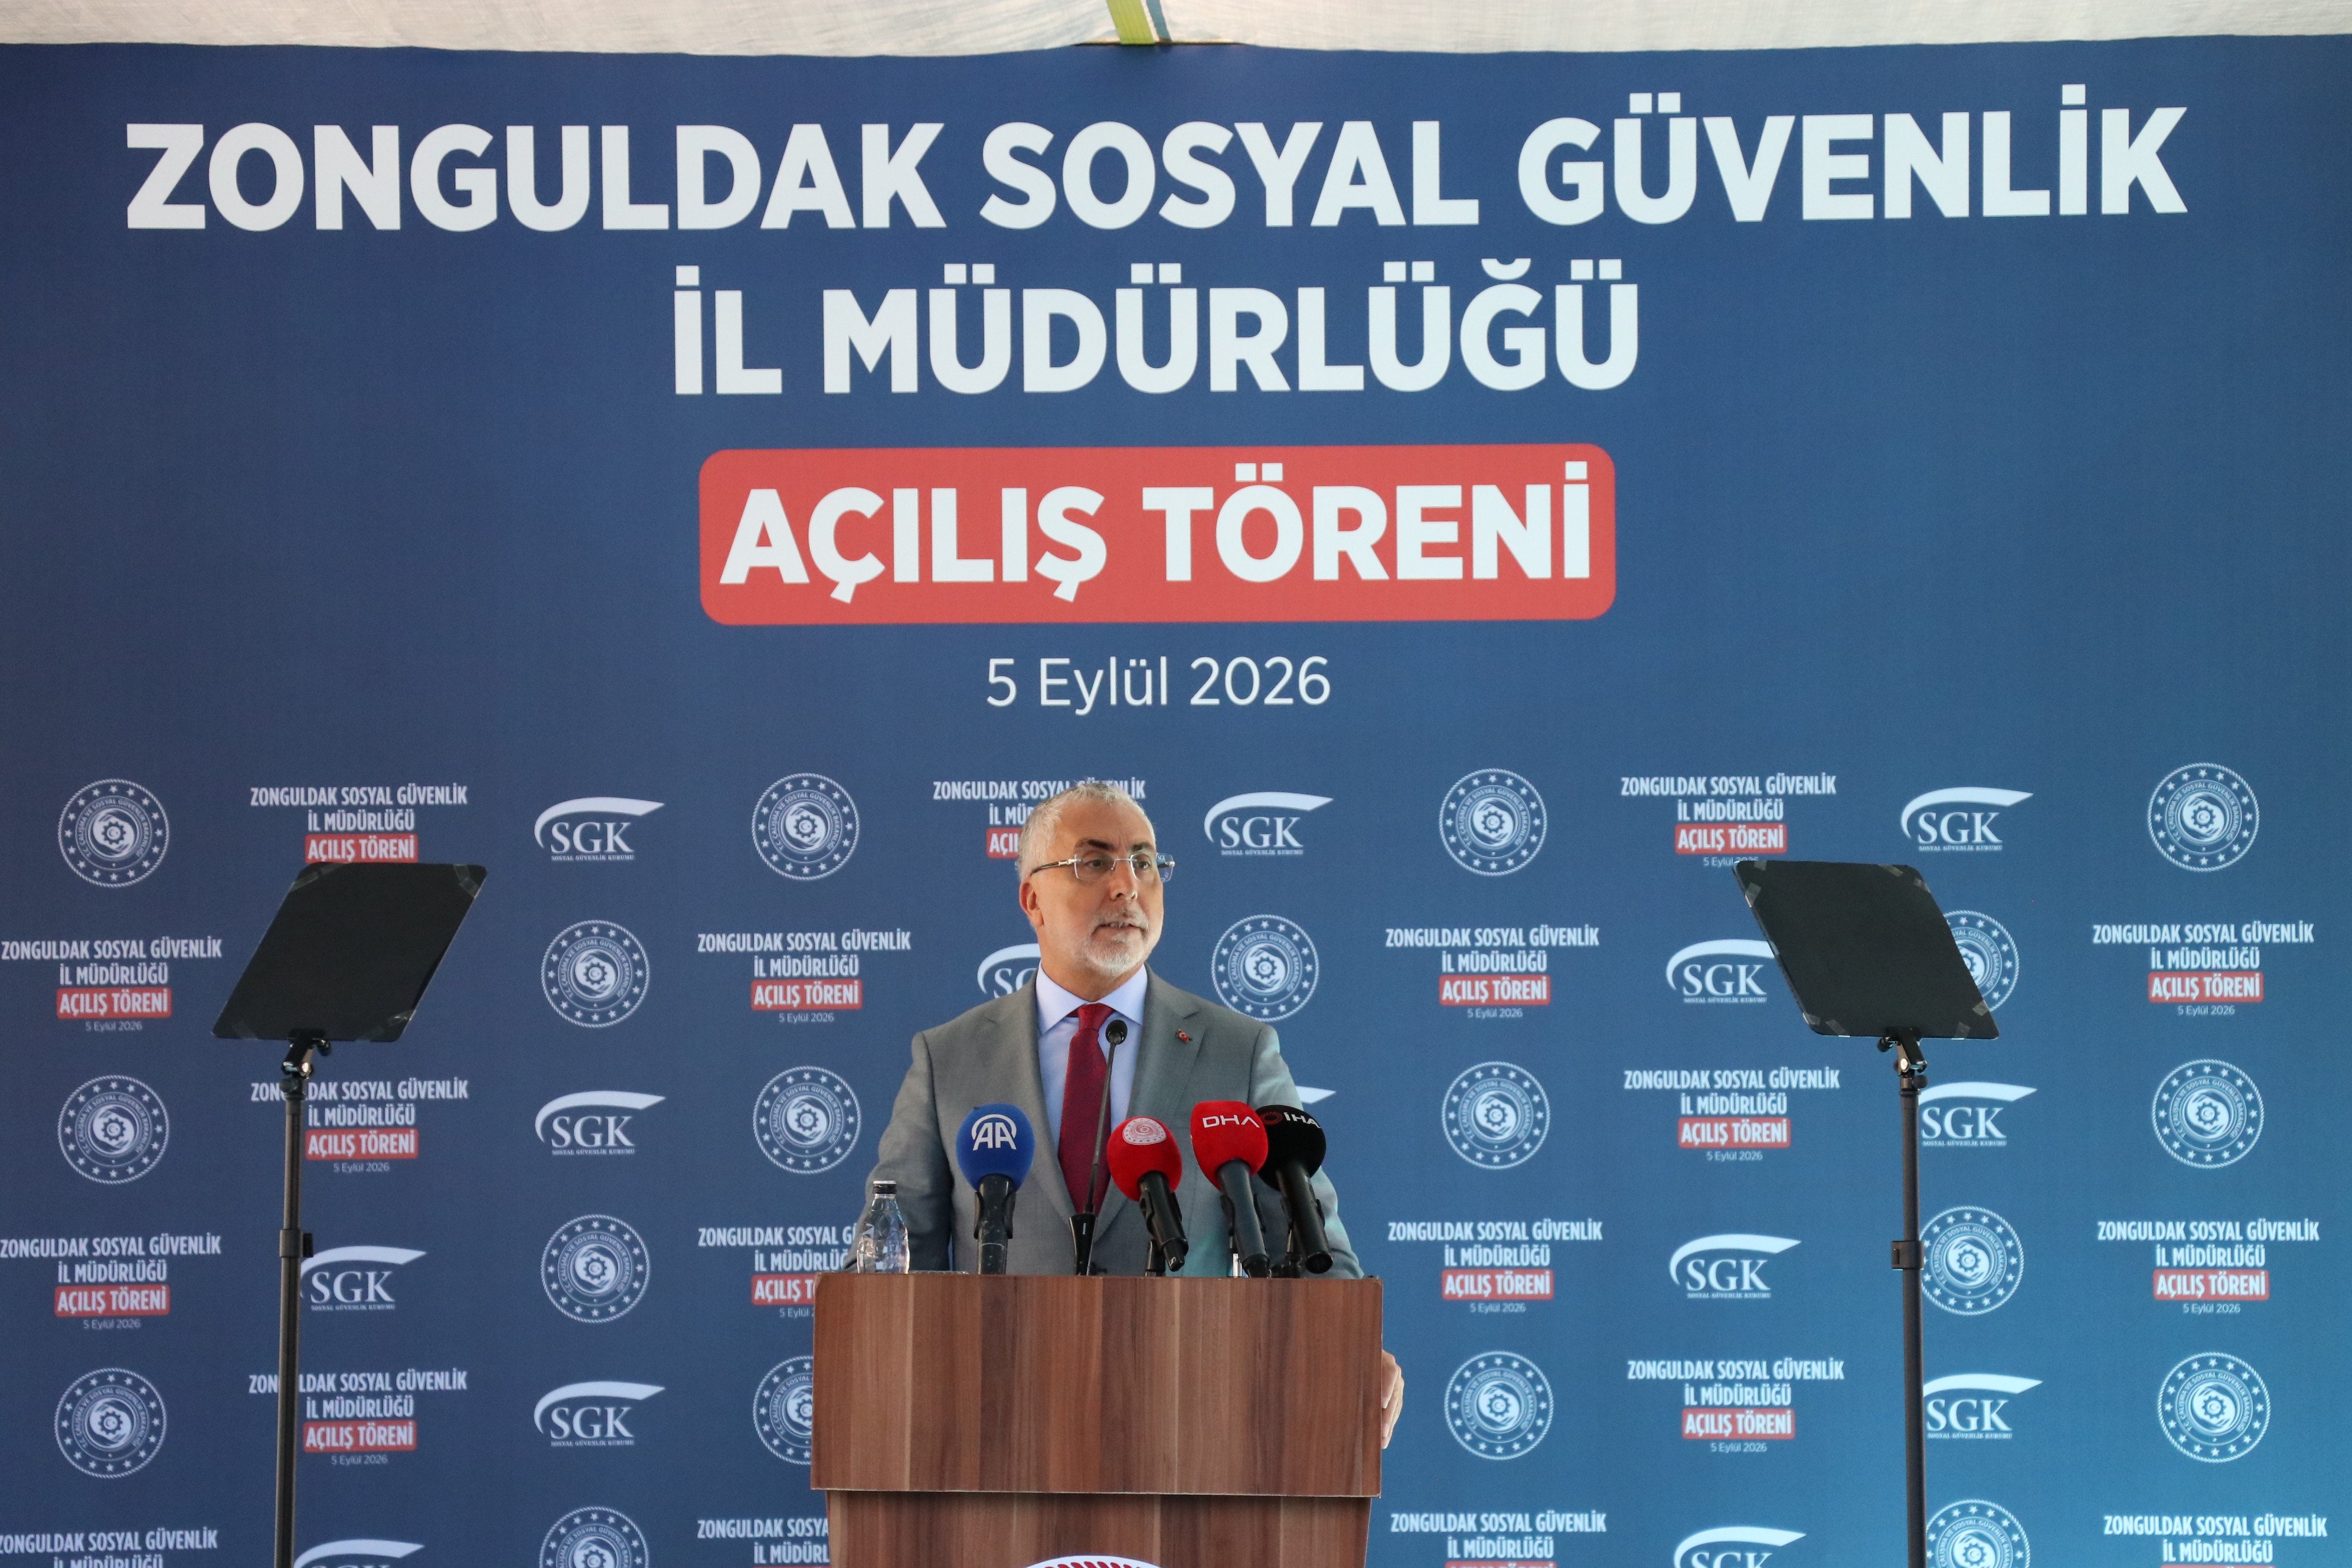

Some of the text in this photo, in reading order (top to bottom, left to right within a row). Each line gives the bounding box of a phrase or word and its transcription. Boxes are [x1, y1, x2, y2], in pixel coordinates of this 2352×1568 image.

[127, 84, 2187, 231] ZONGULDAK SOSYAL GÜVENLİK
[674, 259, 1638, 394] İL MÜDÜRLÜĞÜ
[720, 461, 1590, 603] AÇILIŞ TÖRENİ
[987, 656, 1330, 715] 5 Eylül 2026
[251, 783, 467, 806] ZONGULDAK SOSYAL GÜVENLİK
[933, 780, 1018, 799] ZONGULDAK
[1621, 772, 1836, 796] ZONGULDAK SOSYAL GÜVENLİK
[308, 809, 414, 831] İL MÜDÜRLÜĞÜ
[989, 803, 1001, 825] İL
[1678, 799, 1783, 821] İL MÜDÜRLÜĞÜ
[551, 822, 634, 854] SGK
[1220, 816, 1304, 848] SGK
[1678, 825, 1783, 851] AÇILIŞ TÖRENİ
[1918, 812, 2003, 844] SGK
[308, 835, 414, 862] AÇILIŞ TÖRENİ
[698, 928, 911, 952] ZONGULDAK SOSYAL GÜVENLİK
[1386, 925, 1599, 947] ZONGULDAK SOSYAL GÜVENLİK
[2093, 920, 2314, 943] ZONGULDAK SOSYAL GÜVENLİK
[2, 936, 221, 960] ZONGULDAK SOSYAL GÜVENLİK
[2151, 947, 2259, 969] İL MÜDÜRLÜĞÜ
[754, 955, 859, 977] İL MÜDÜRLÜĞÜ
[1442, 950, 1547, 972] İL MÜDÜRLÜĞÜ
[60, 962, 168, 985] İL MÜDÜRLÜĞÜ
[1683, 964, 1767, 996] SGK
[754, 981, 858, 1008] AÇILIŞ TÖRENİ
[1442, 976, 1547, 1003] AÇILIŞ TÖRENİ
[2151, 973, 2260, 1000] AÇILIŞ TÖRENİ
[60, 989, 168, 1016] AÇILIŞ TÖRENİ
[2177, 1005, 2184, 1014] 5
[2211, 1005, 2235, 1015] 2026
[85, 1021, 92, 1030] 5
[118, 1021, 142, 1030] 2026
[779, 1012, 785, 1022] 5
[811, 1012, 834, 1022] 2026
[251, 1077, 468, 1101] ZONDAK SOSYAL GÜVENLİK
[1624, 1067, 1840, 1089] ZONGULDAK SOSYAL GÜVENLİK
[309, 1103, 415, 1126] İL MÜDÜRLÜĞÜ
[1681, 1093, 1787, 1115] İL MÜDÜRLÜĞÜ
[551, 1116, 635, 1148] SGK
[1203, 1115, 1260, 1128] DHA
[1681, 1119, 1787, 1145] AÇILIŞ TÖRENİ
[1921, 1107, 2007, 1139] SGK
[308, 1129, 414, 1157] AÇILIŞ TÖRENİ
[973, 1122, 1017, 1151] AA
[698, 1227, 784, 1246] ZONGULDAK
[788, 1226, 838, 1244] SOSYAL
[2098, 1219, 2320, 1240] ZONGULDAK SOSYAL GÜVENLİK
[0, 1233, 221, 1257] ZONGULDAK SOSYAL GÜVENLİK
[2157, 1244, 2265, 1267] İL MÜDÜRLÜĞÜ
[58, 1259, 166, 1283] İL MÜDÜRLÜĞÜ
[754, 1250, 767, 1271] İL
[311, 1270, 395, 1304] SGK
[1686, 1259, 1771, 1291] SGK
[2157, 1270, 2265, 1298] AÇILIŞ TÖRENİ
[58, 1286, 166, 1314] AÇILIŞ TÖRENİ
[754, 1280, 801, 1302] AÇILIŞ
[2183, 1303, 2189, 1313] 5
[2216, 1303, 2240, 1313] 2026
[249, 1368, 467, 1393] ZONLDAK SOSYAL GÜVENLİK
[1628, 1357, 1844, 1380] ZONGULDAK SOSYAL GÜVENLİK
[1685, 1383, 1791, 1406] İL MÜDÜRLÜĞÜ
[306, 1395, 414, 1419] İL MÜDÜRLÜĞÜ
[1926, 1399, 2013, 1432] SGK
[551, 1407, 634, 1439] SGK
[1685, 1409, 1792, 1437] AÇILIŞ TÖRENİ
[306, 1422, 413, 1450] AÇILIŞ TÖRENİ
[1710, 1442, 1717, 1452] 5
[1743, 1442, 1767, 1452] 2026
[697, 1518, 828, 1538] ZONGULDAK SOSYA
[2104, 1514, 2327, 1537] ZONGULDAK SOSYAL GÜVENLİK
[754, 1541, 829, 1563] İL MÜDÜRL
[2163, 1539, 2273, 1562] İL MÜDÜRLÜĞÜ
